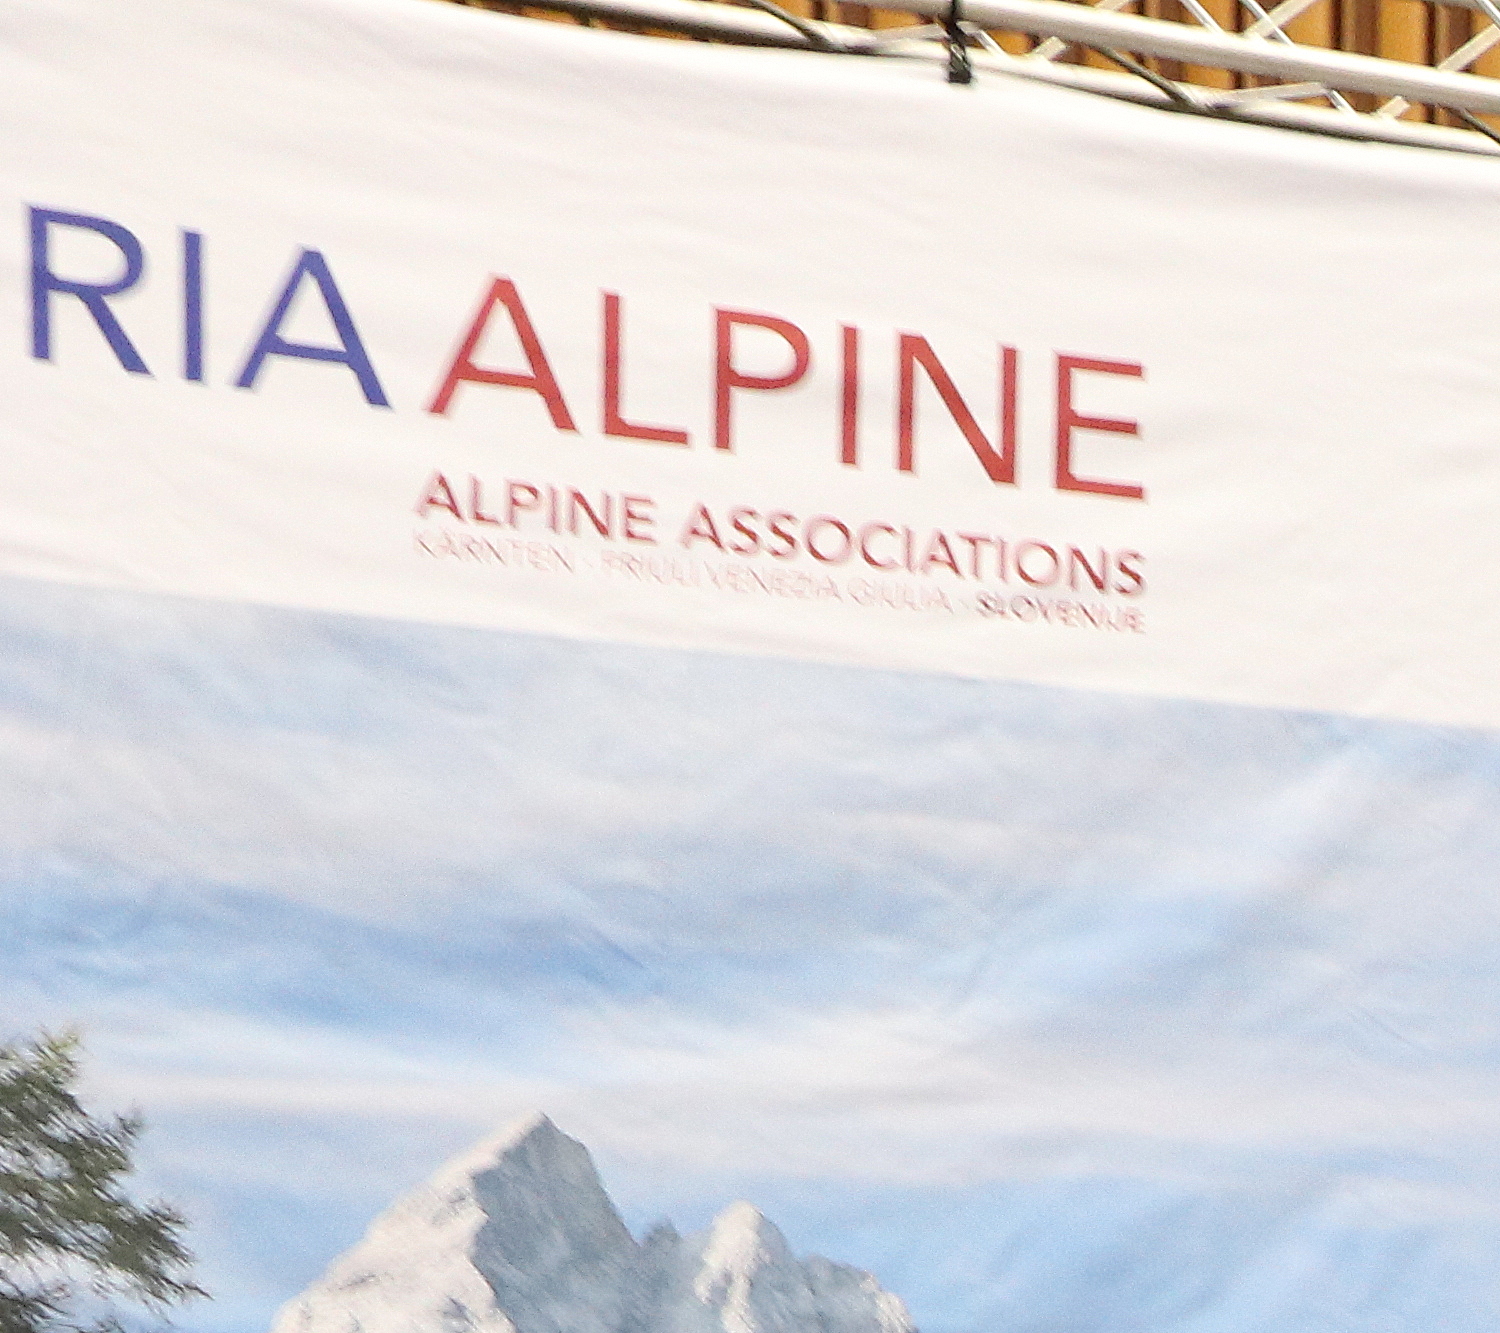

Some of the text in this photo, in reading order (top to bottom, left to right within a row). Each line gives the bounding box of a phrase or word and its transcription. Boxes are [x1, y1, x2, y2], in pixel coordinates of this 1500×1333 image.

[425, 275, 1148, 504] ALPINE
[414, 471, 1149, 597] ALPINE ASSOCIATIONS
